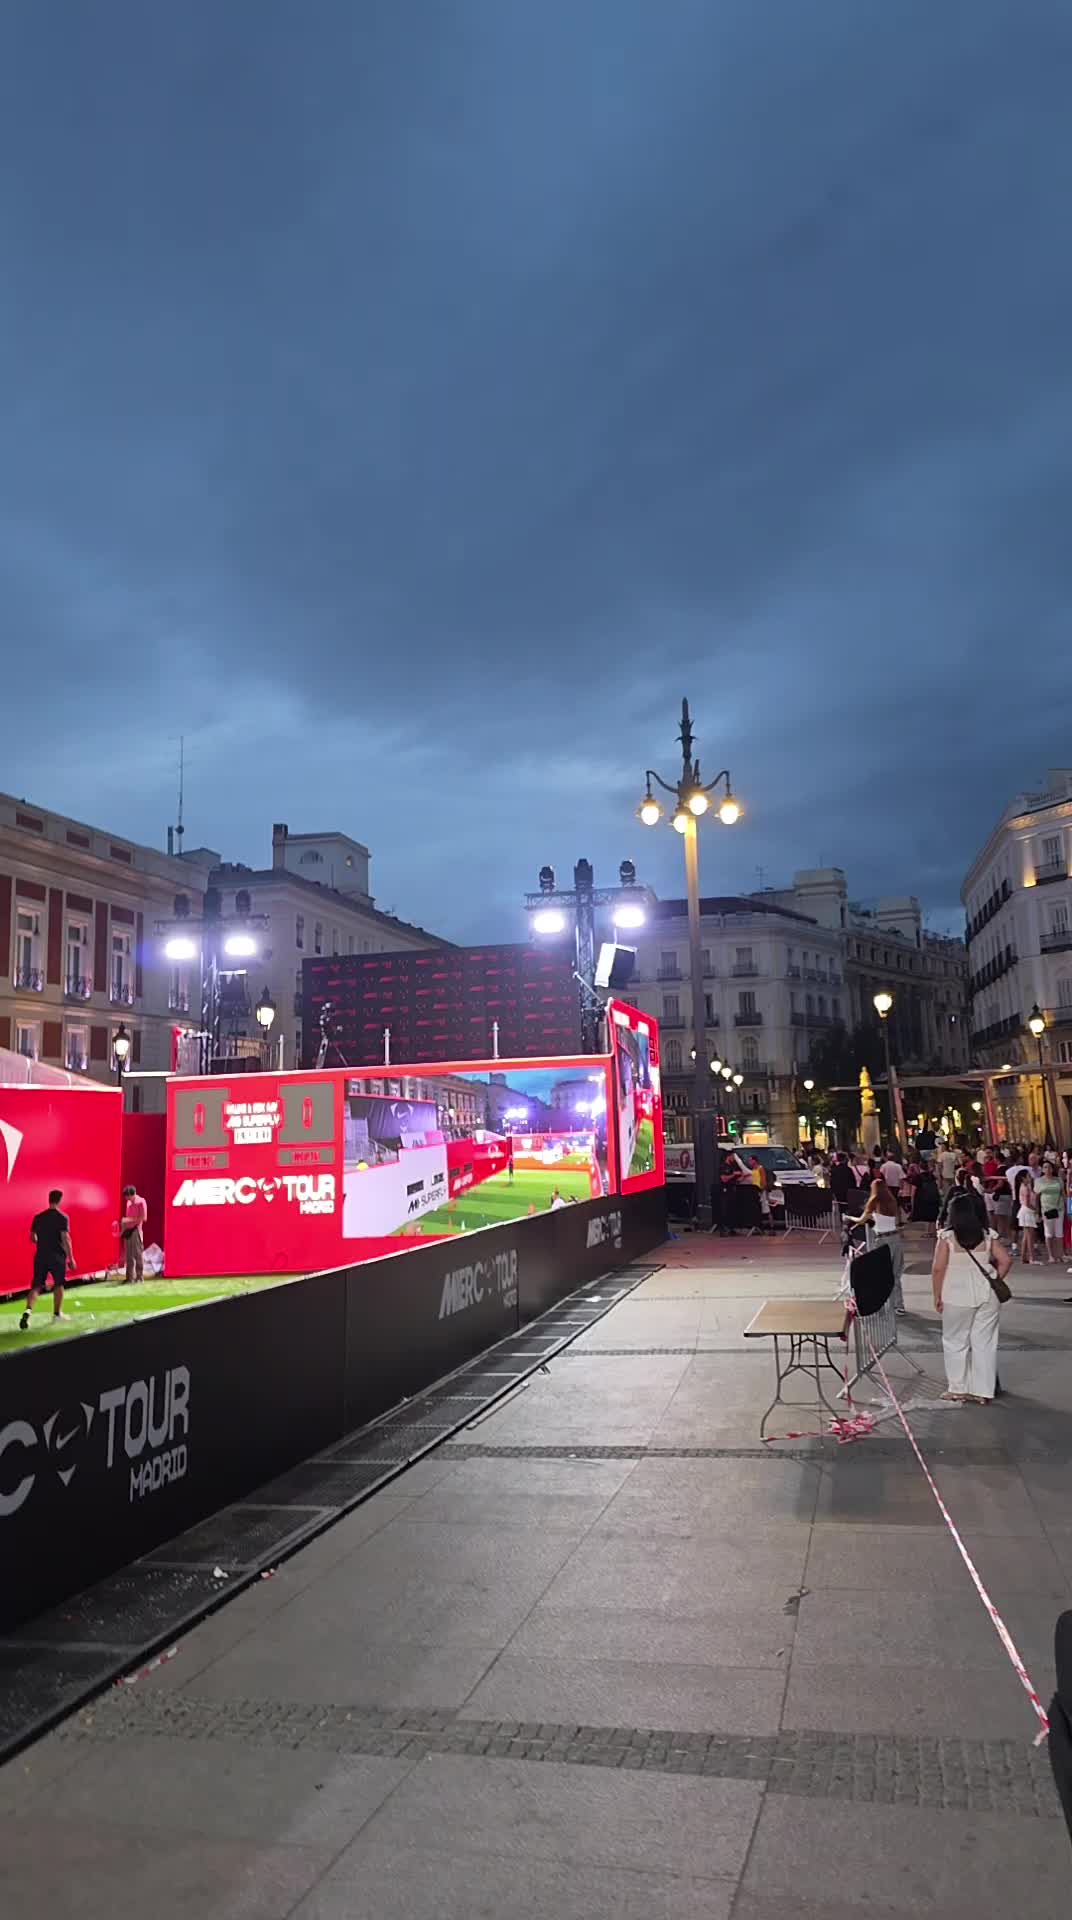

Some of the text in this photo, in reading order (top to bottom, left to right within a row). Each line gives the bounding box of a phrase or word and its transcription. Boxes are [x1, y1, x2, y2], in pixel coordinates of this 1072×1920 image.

[282, 1174, 335, 1202] TOUR
[496, 1249, 517, 1293] TOUR
[100, 1365, 190, 1468] TOUR
[130, 1444, 187, 1503] MADRID
